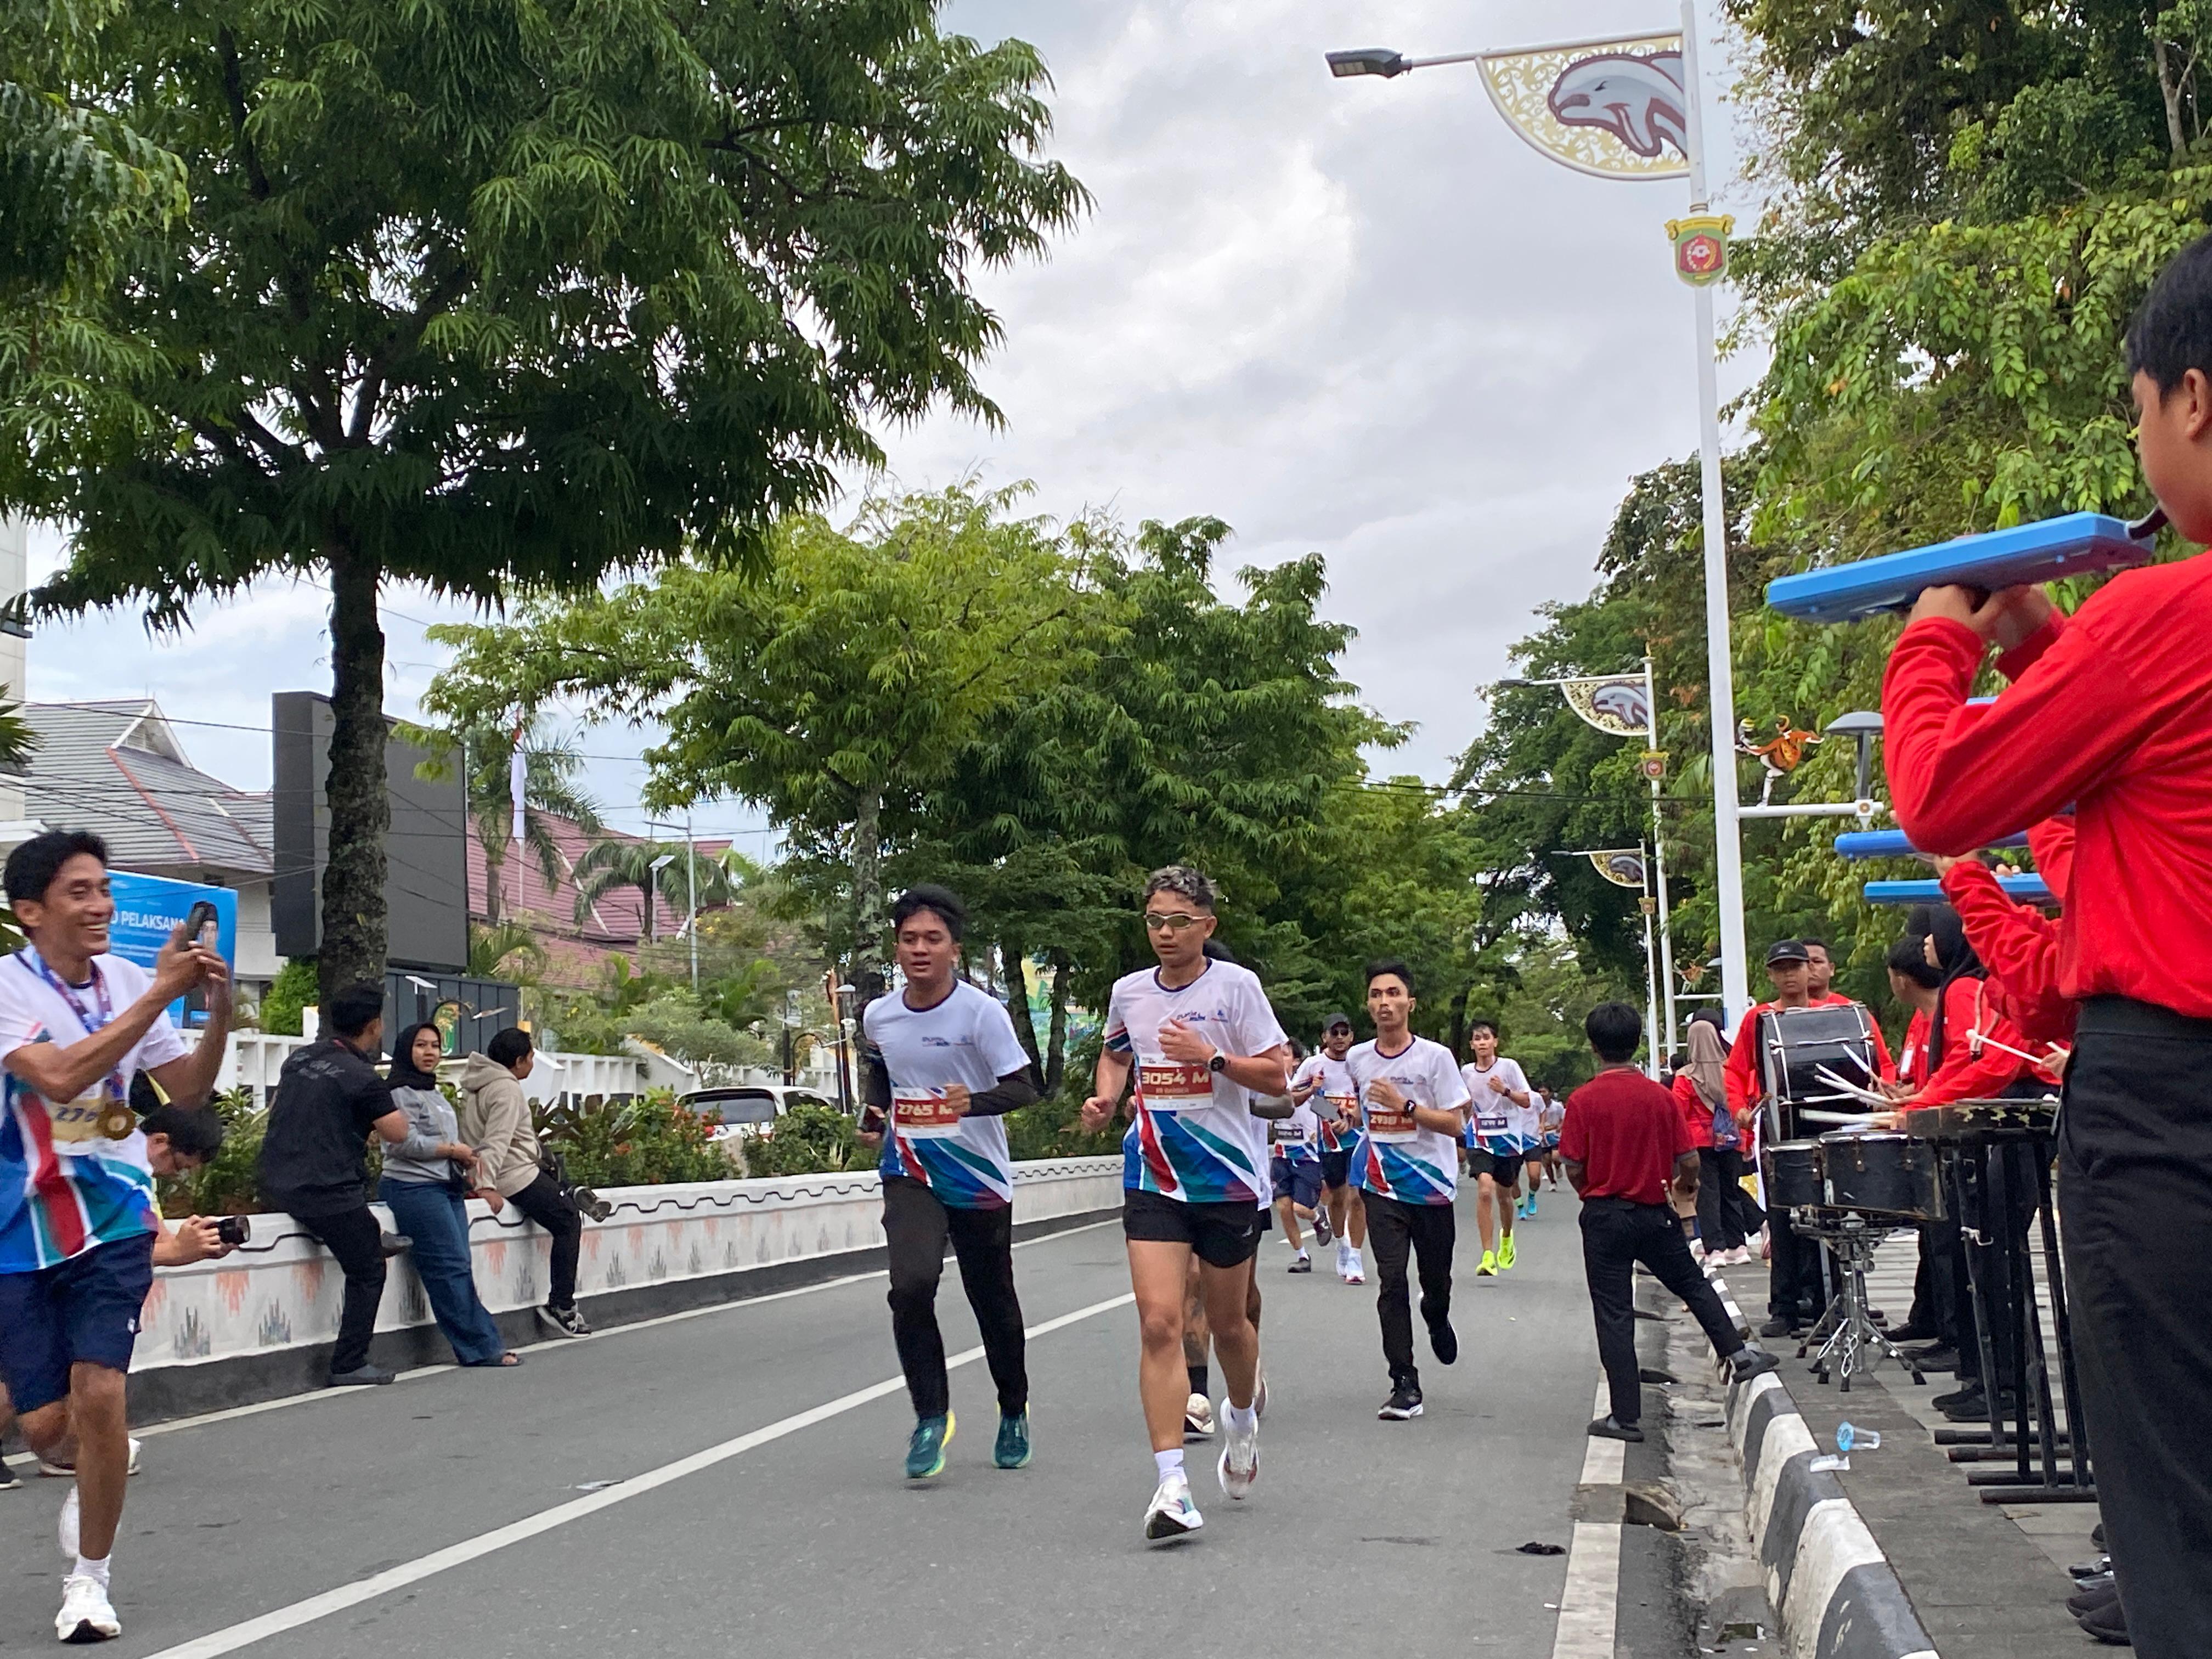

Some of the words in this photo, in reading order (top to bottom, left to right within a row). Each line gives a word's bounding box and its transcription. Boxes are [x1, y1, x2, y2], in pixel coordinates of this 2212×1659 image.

[1141, 1071, 1186, 1085] 3054
[1192, 1071, 1209, 1084] M
[897, 1103, 934, 1116] 2765
